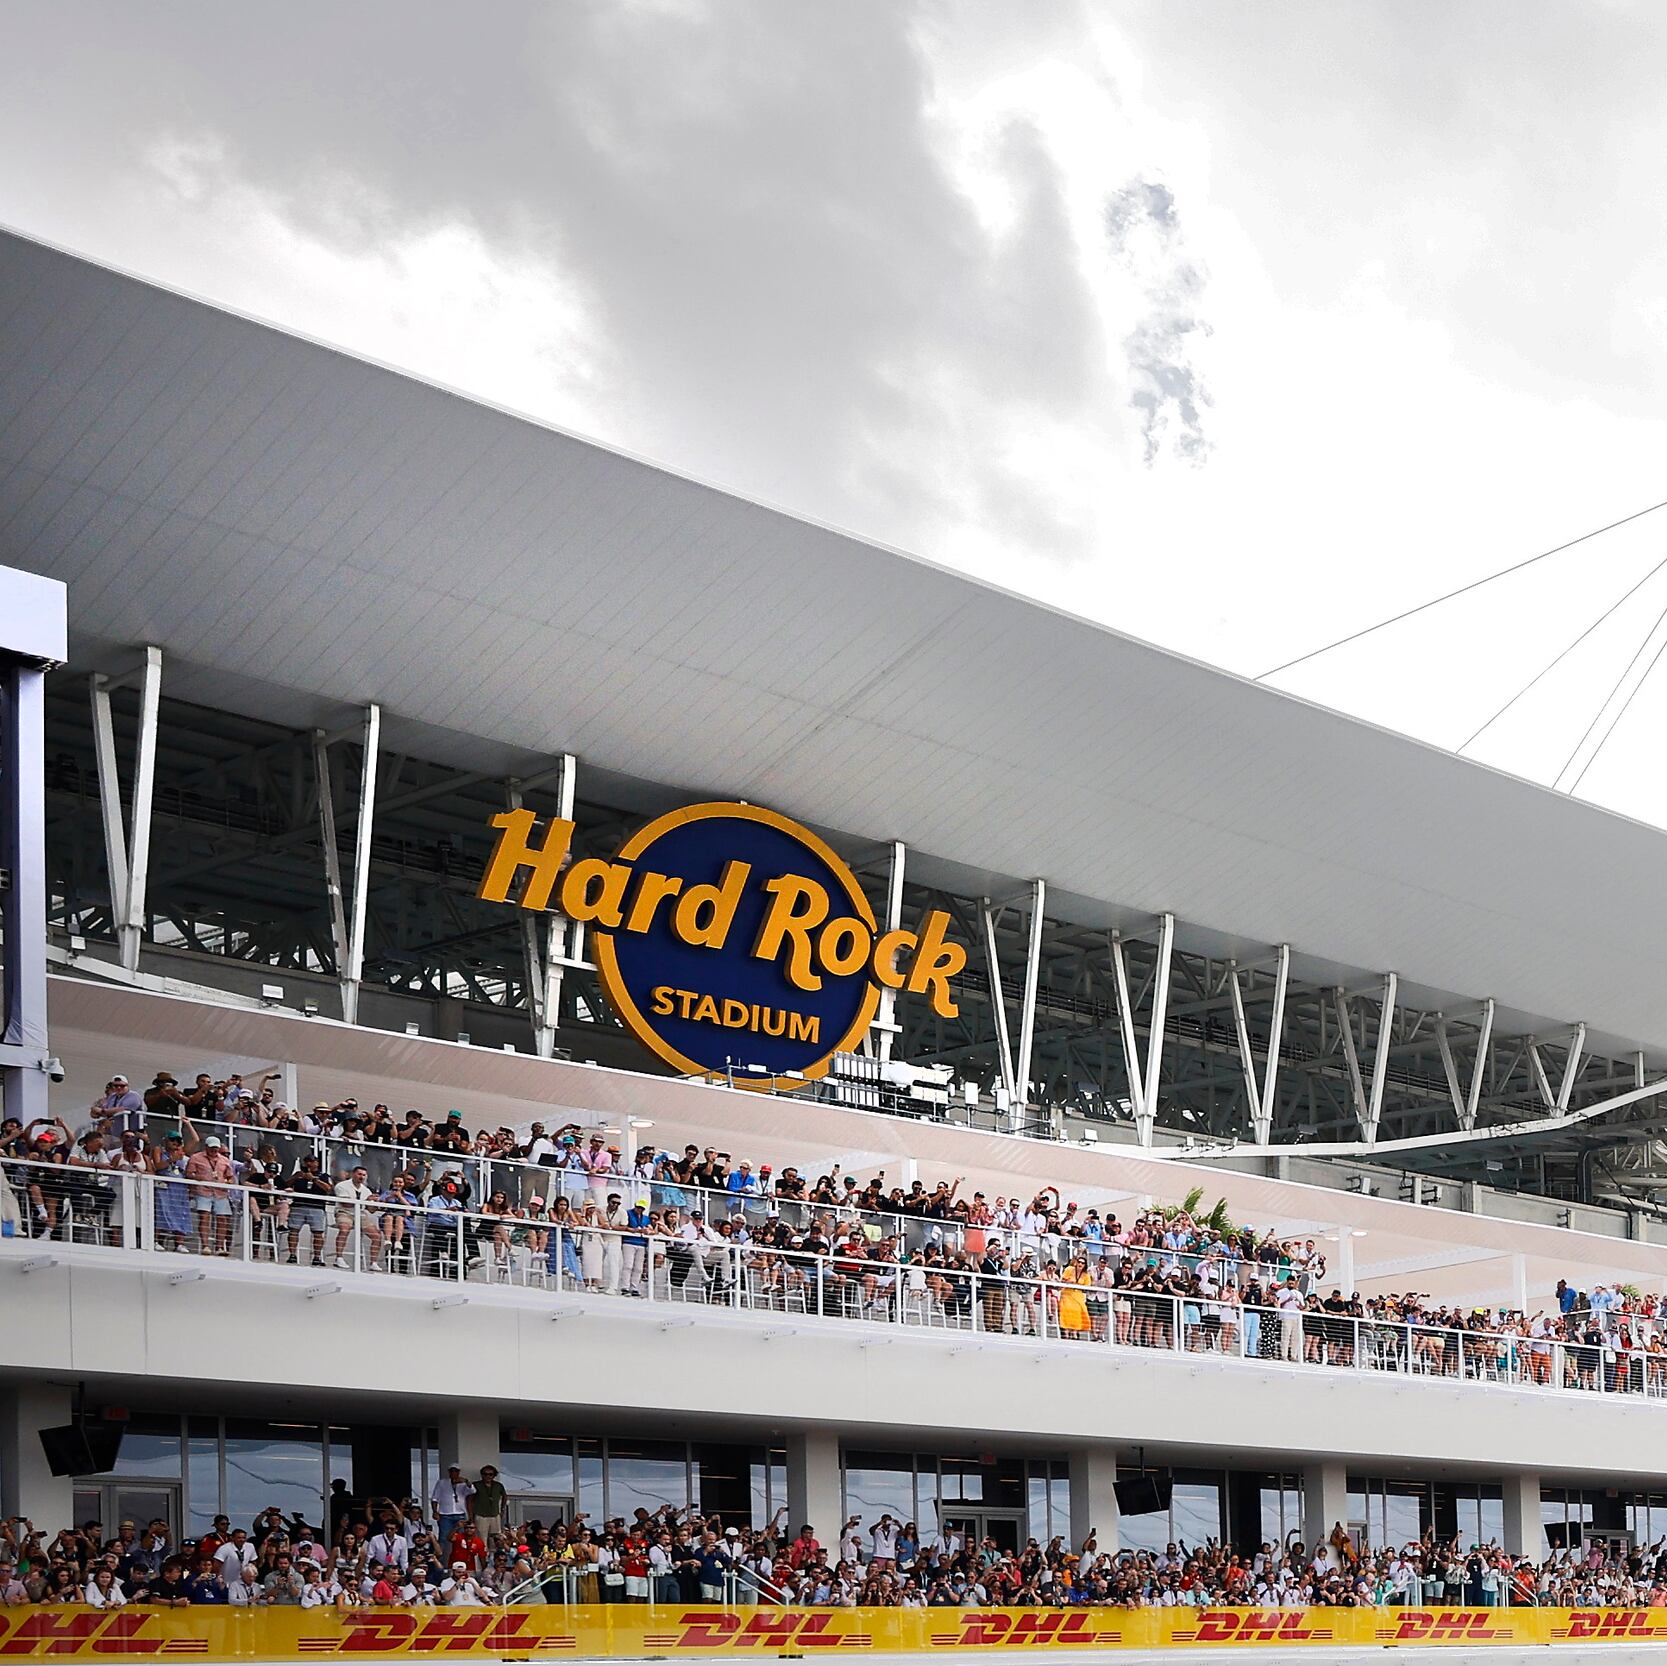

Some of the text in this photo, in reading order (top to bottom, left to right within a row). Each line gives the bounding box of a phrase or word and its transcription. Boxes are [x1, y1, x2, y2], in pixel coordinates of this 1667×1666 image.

[475, 808, 968, 1018] Hard Rock
[650, 985, 820, 1044] STADIUM
[0, 1613, 166, 1655] HL
[337, 1612, 543, 1652] DHL
[678, 1612, 841, 1648] DHL
[959, 1612, 1097, 1645] DHL
[1196, 1612, 1311, 1641] DHL
[1394, 1612, 1492, 1639] DHL
[1567, 1612, 1653, 1637] DHL
